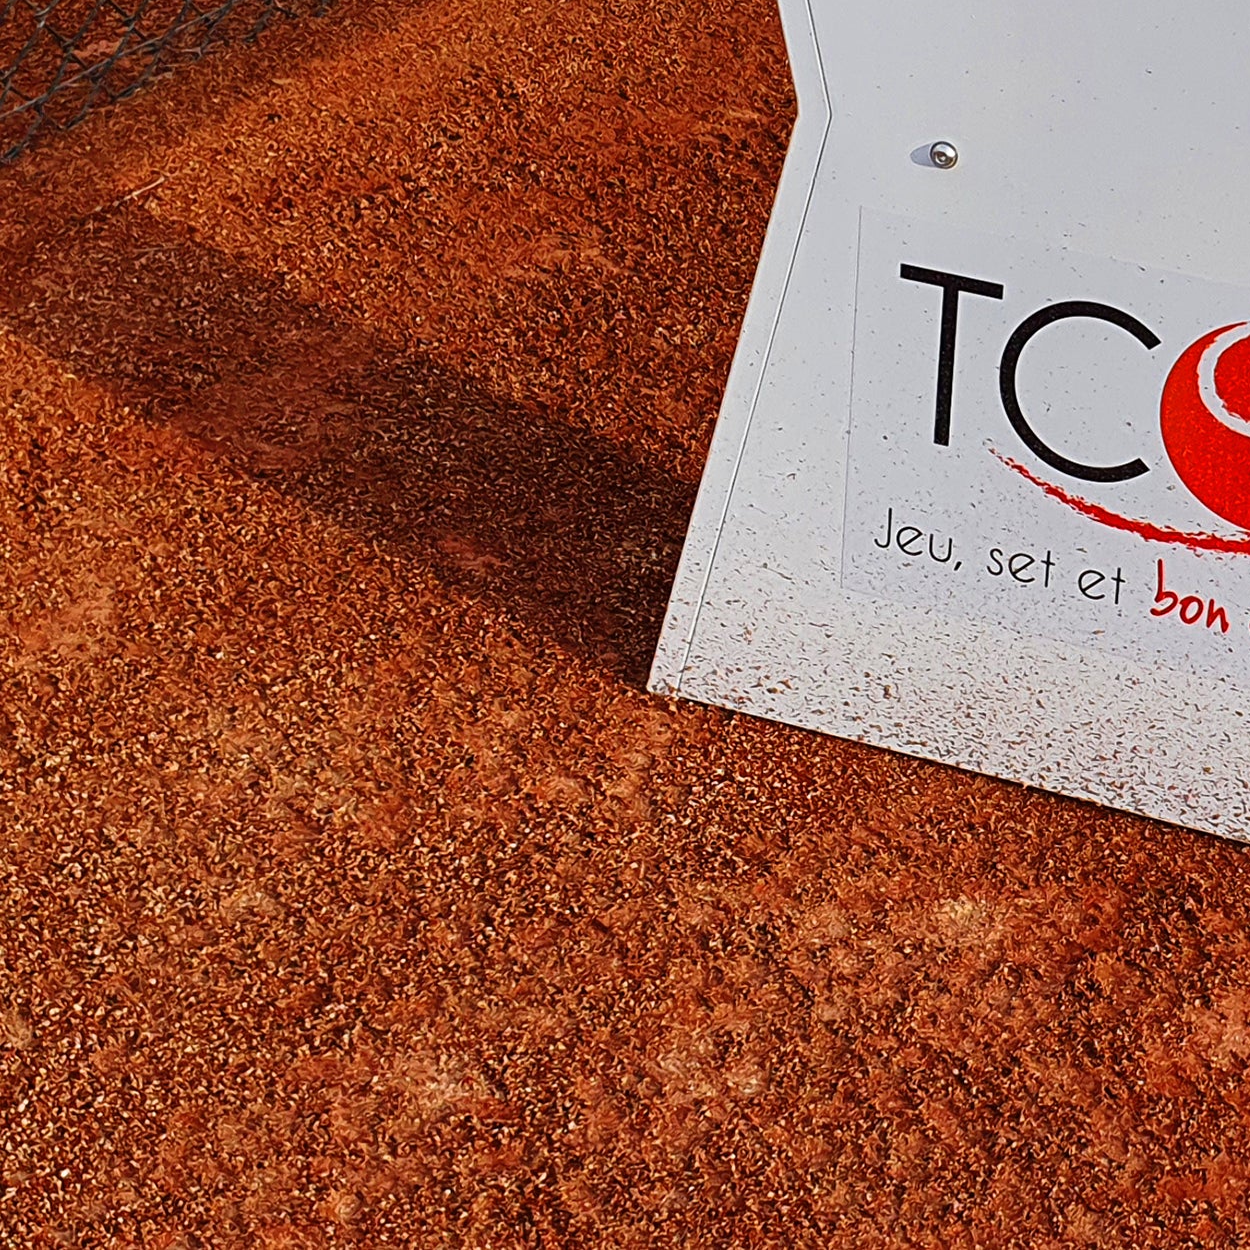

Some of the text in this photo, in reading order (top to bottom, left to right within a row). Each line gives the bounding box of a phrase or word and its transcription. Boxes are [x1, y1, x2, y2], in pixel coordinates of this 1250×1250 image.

[873, 507, 963, 572] Jeu,
[985, 545, 1056, 589] set
[1077, 567, 1127, 605] et
[1149, 558, 1229, 634] bon
